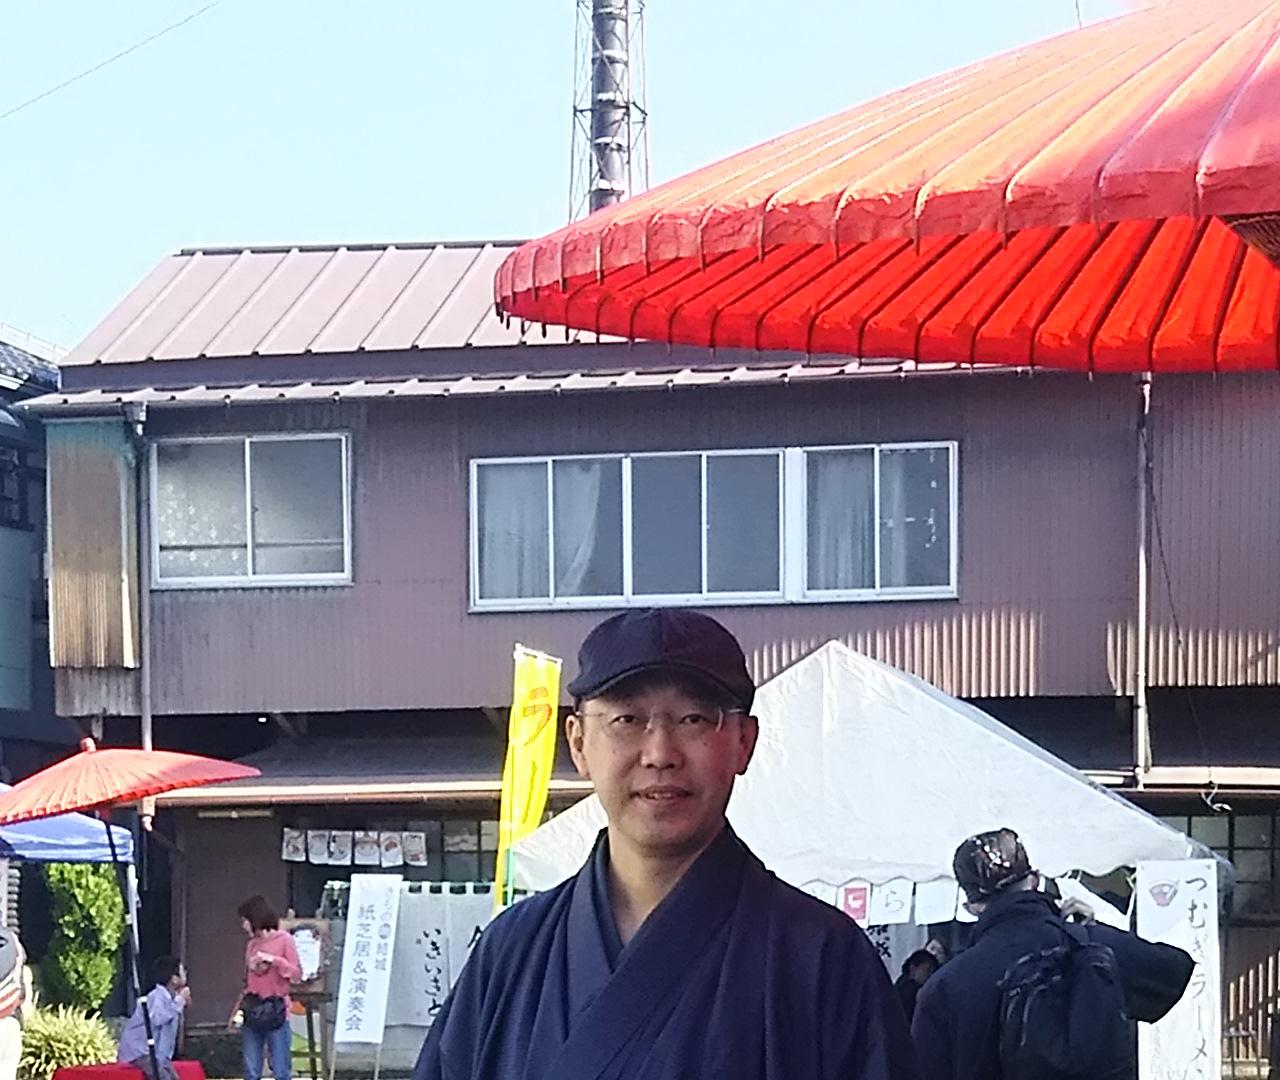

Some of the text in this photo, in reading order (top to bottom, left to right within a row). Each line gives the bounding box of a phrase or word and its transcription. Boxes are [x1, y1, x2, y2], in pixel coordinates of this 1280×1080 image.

[344, 904, 376, 1032] 紙芝居&演奏会
